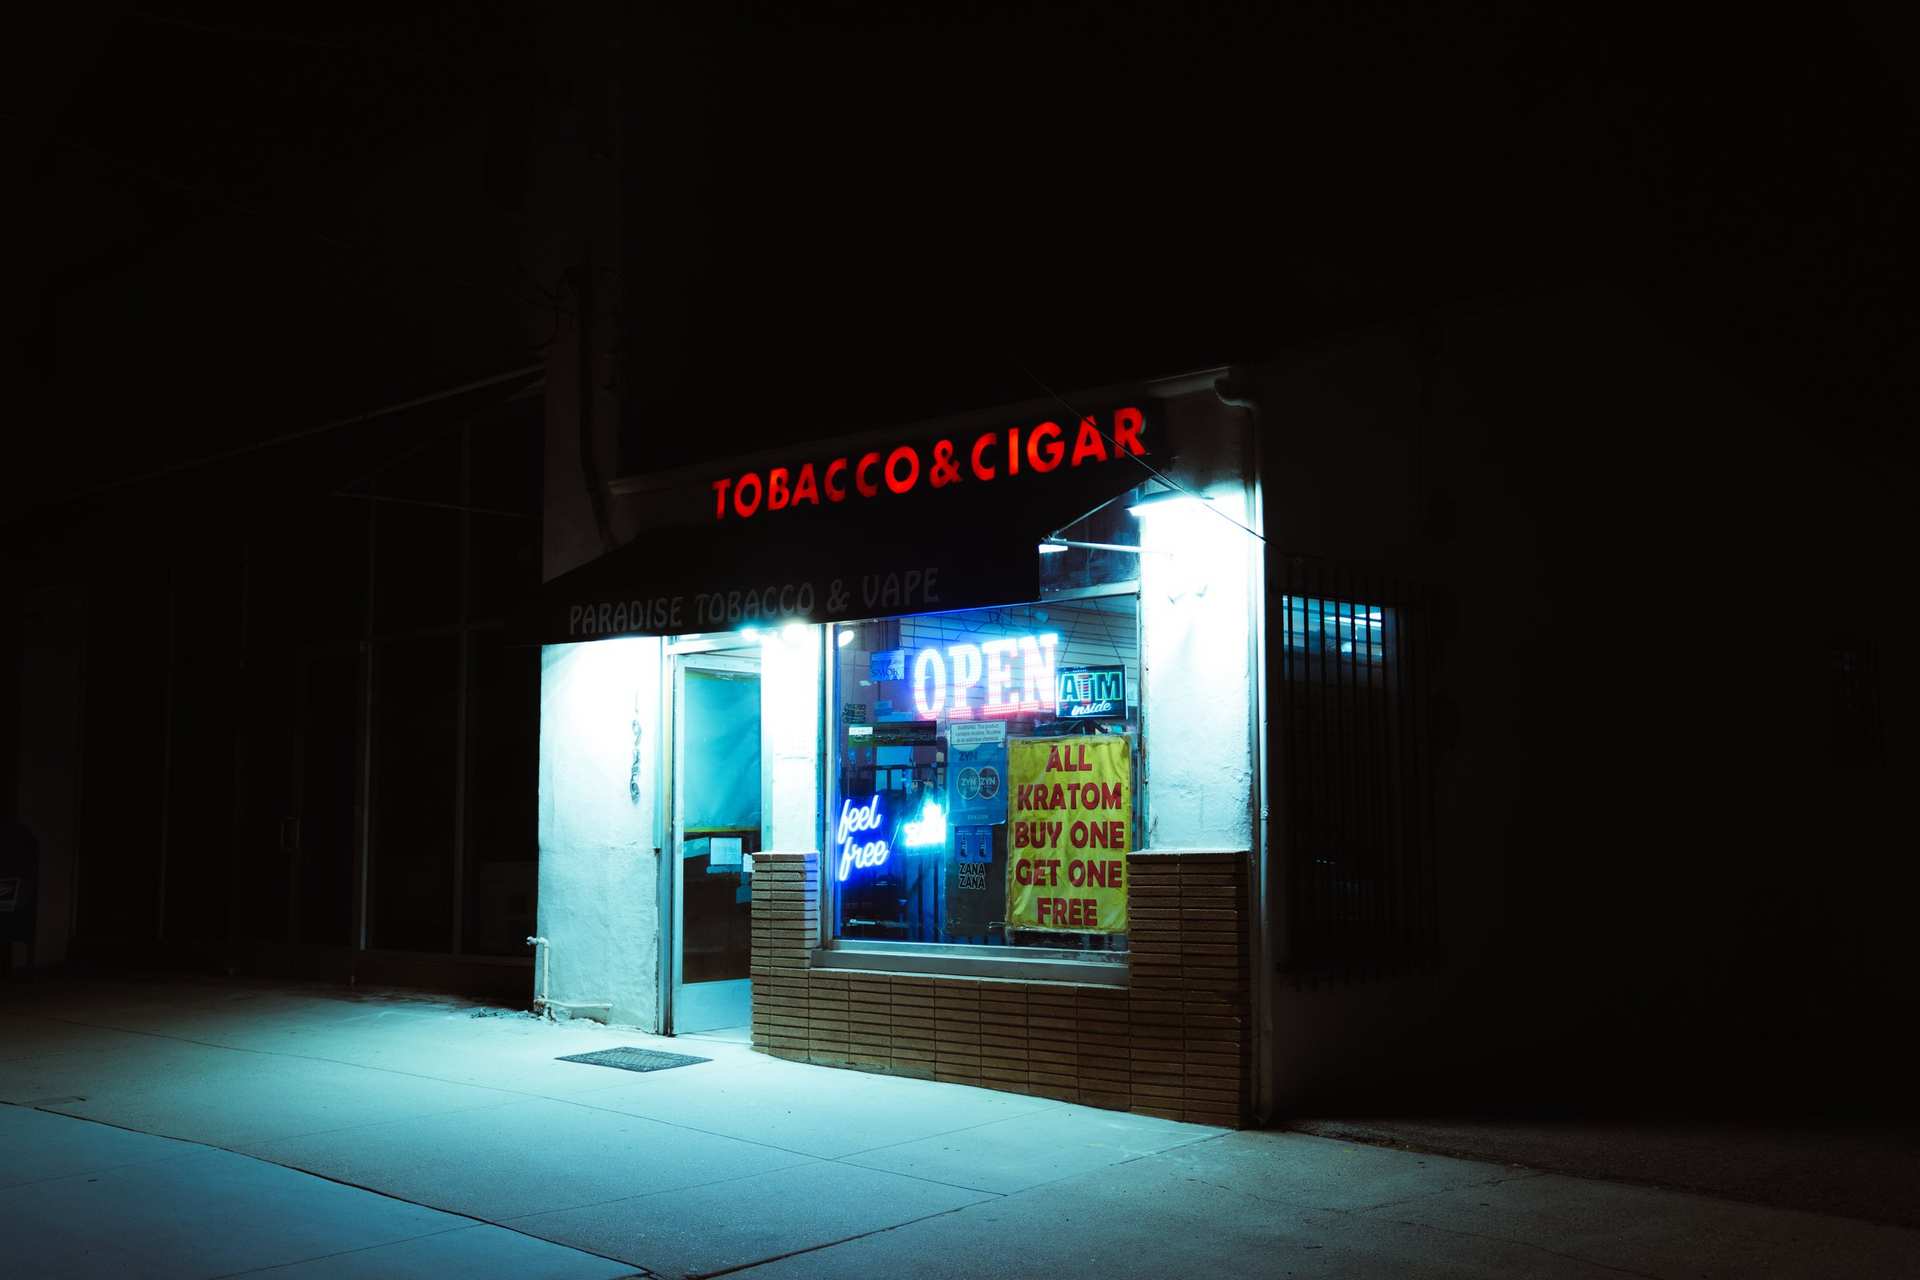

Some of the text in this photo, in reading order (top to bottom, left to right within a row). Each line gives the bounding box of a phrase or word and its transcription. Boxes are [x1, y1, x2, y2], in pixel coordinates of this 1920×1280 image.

[712, 407, 1146, 520] TOBACCO & CIGAR
[570, 568, 941, 635] PARADISE TOBACCO & VAPE
[914, 632, 1059, 719] OPEN
[1060, 671, 1123, 701] ATM
[1071, 700, 1112, 716] inside
[1045, 744, 1092, 772] ALL
[1017, 782, 1122, 811] KRATOM
[838, 795, 883, 844] feel
[1014, 820, 1125, 849] BUY ONE
[839, 836, 890, 881] free
[959, 863, 985, 876] ZANA
[959, 876, 986, 890] ZANA
[1015, 859, 1123, 888] GET ONE
[1037, 897, 1098, 926] FREE
